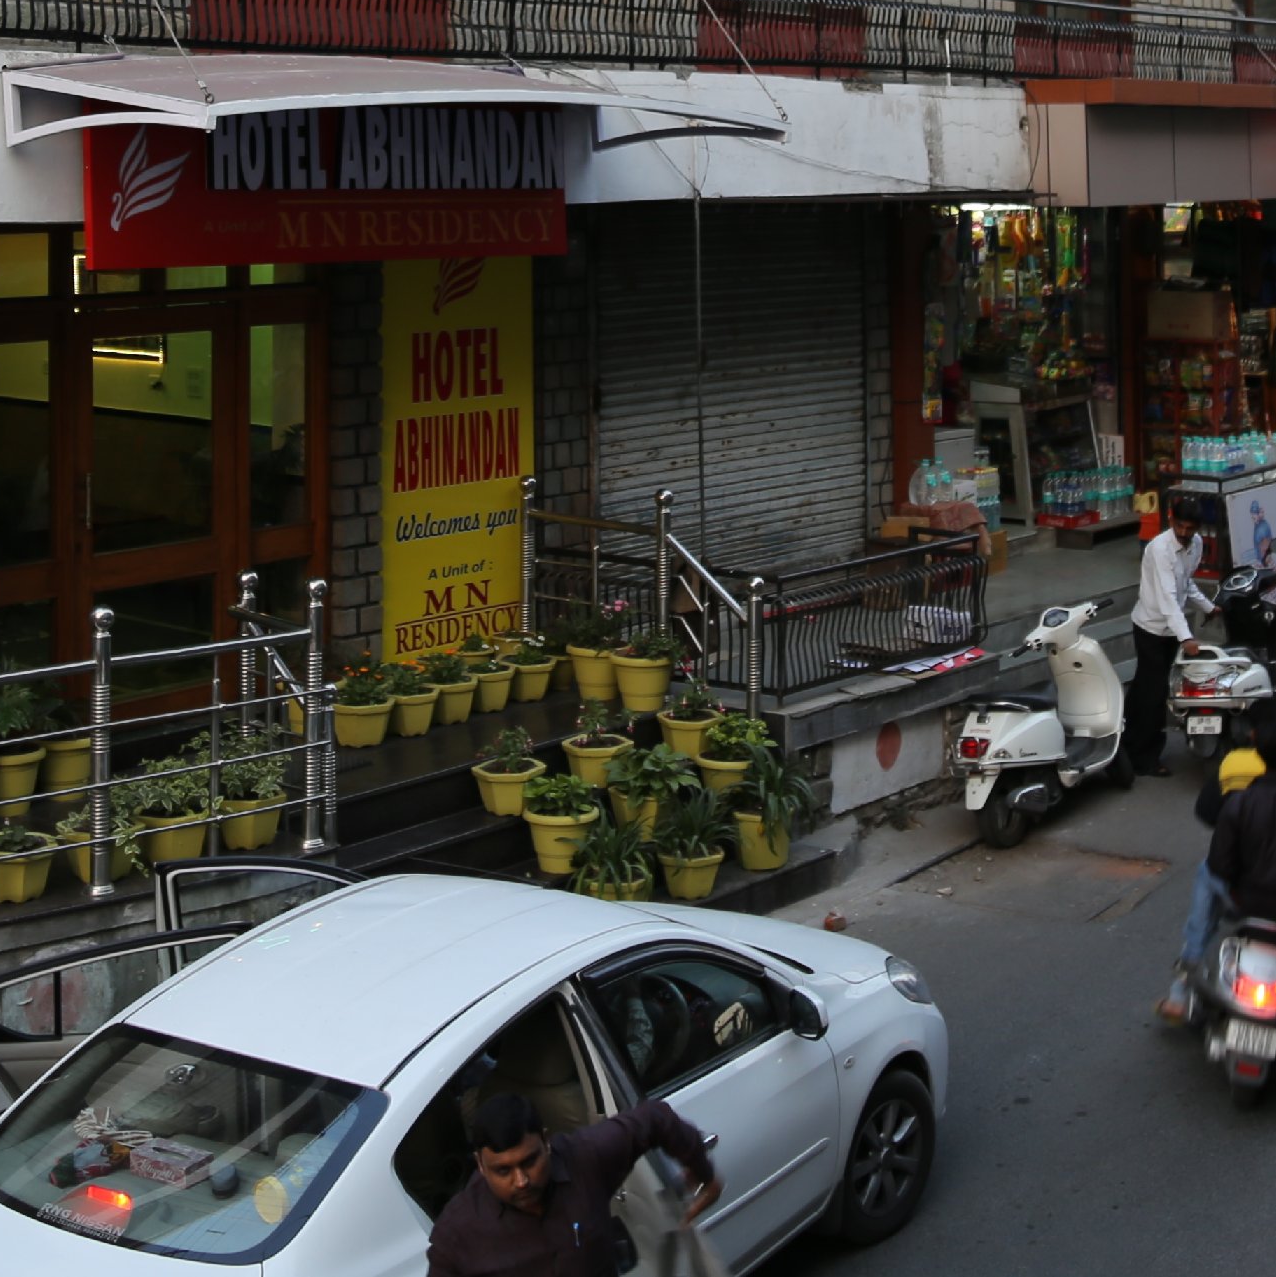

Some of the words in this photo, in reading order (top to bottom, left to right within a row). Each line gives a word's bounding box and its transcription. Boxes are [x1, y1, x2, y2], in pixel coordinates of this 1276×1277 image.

[213, 108, 327, 191] HOTEL
[339, 105, 565, 191] ABHINANDAN
[277, 210, 310, 249] M
[321, 210, 347, 248] N
[358, 208, 554, 246] RESIDENCY
[412, 327, 503, 404] HOTEL
[393, 407, 520, 493] ABHINANDAN
[395, 511, 480, 542] Welcomes
[486, 507, 517, 536] you
[428, 568, 438, 581] A
[441, 562, 469, 579] Unit
[471, 559, 486, 573] of
[424, 585, 456, 618] M
[464, 579, 492, 609] N
[395, 604, 519, 655] RESIDENCY
[41, 1202, 73, 1218] RNG
[71, 1212, 126, 1237] NISSAN
